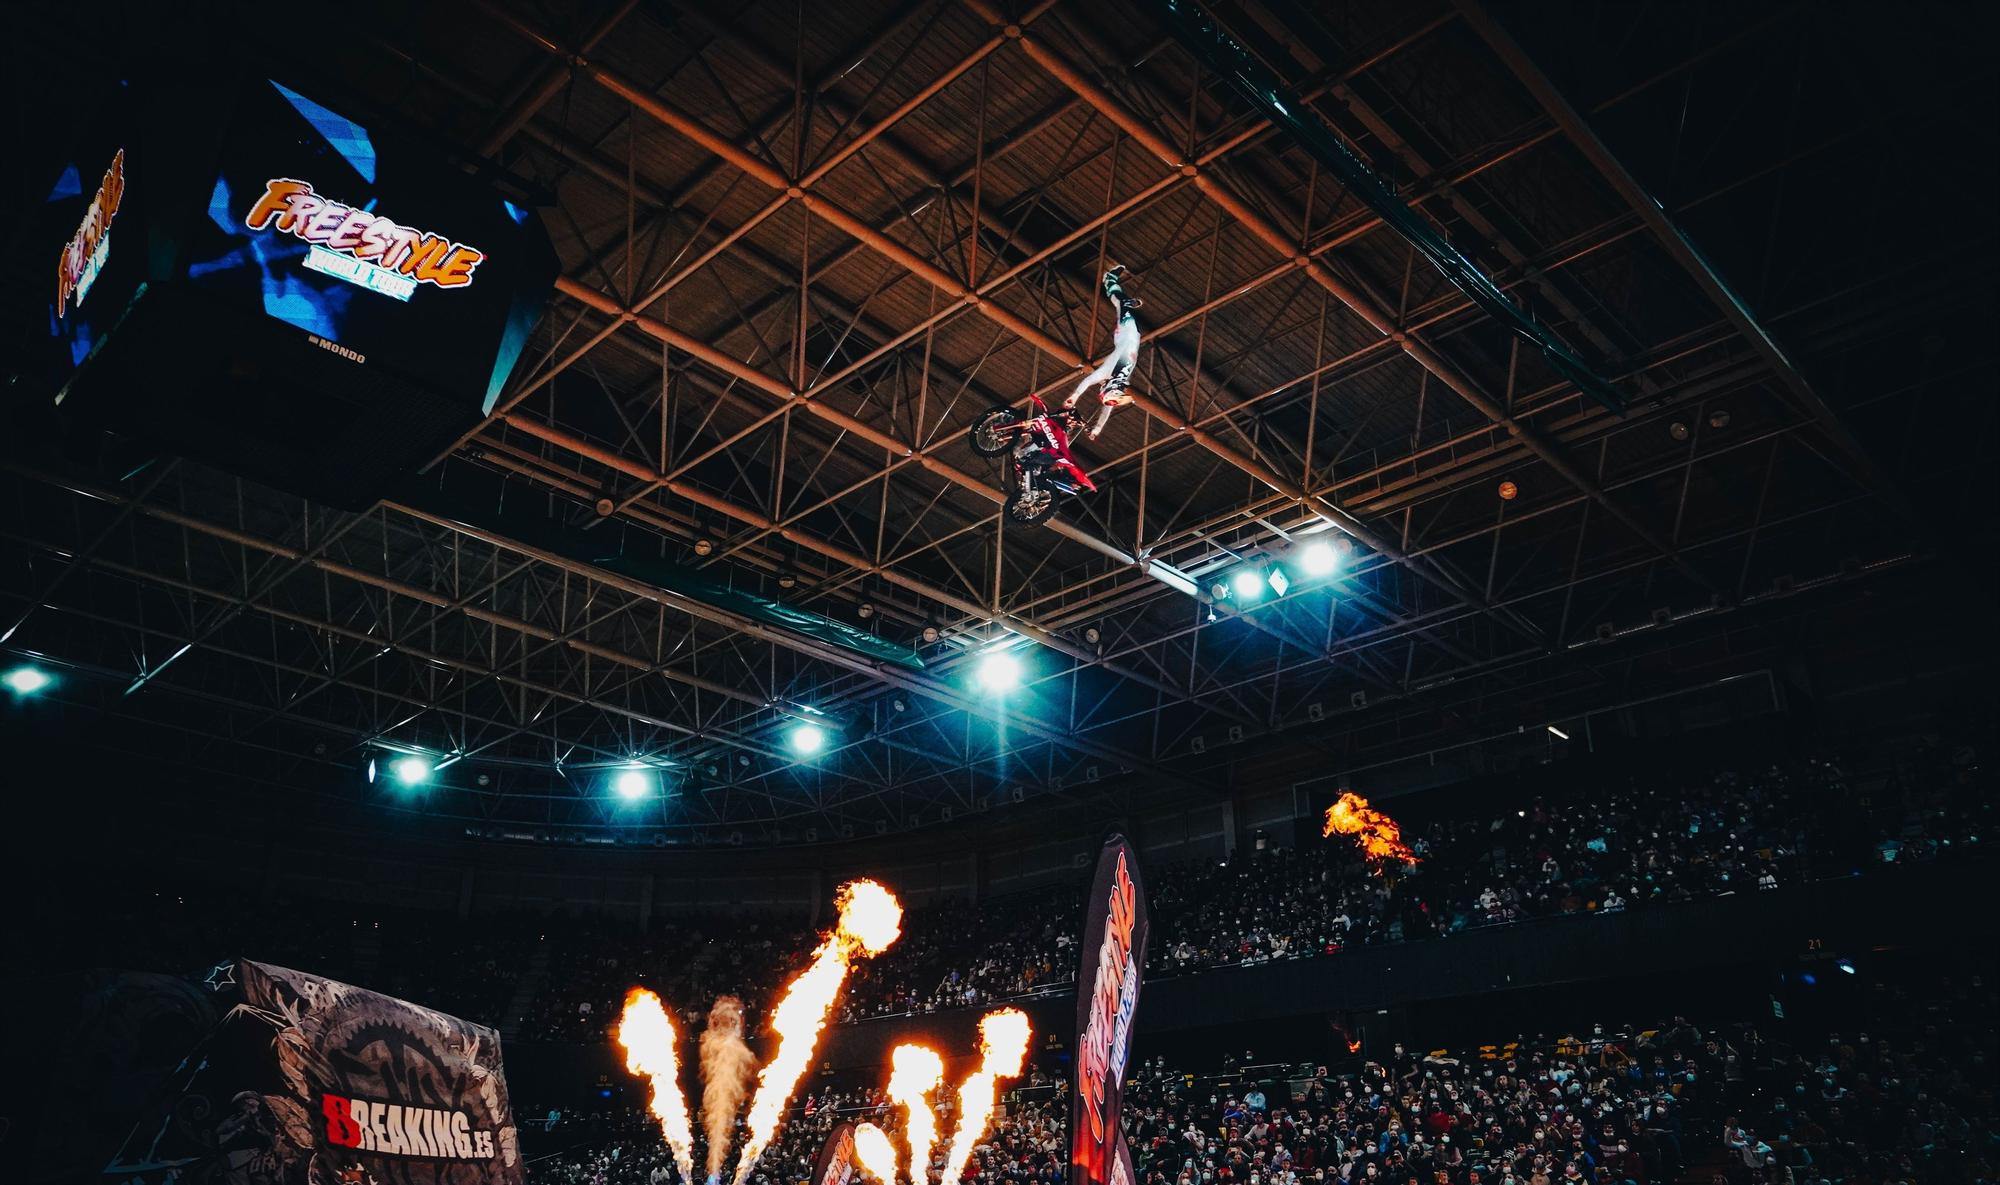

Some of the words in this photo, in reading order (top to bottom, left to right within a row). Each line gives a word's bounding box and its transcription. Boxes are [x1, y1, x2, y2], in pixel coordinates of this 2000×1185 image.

[247, 178, 482, 288] FREESTYLE
[319, 338, 366, 364] MONDO
[1079, 852, 1136, 1143] FREESTYLE
[322, 1093, 495, 1159] BREAKING.ES
